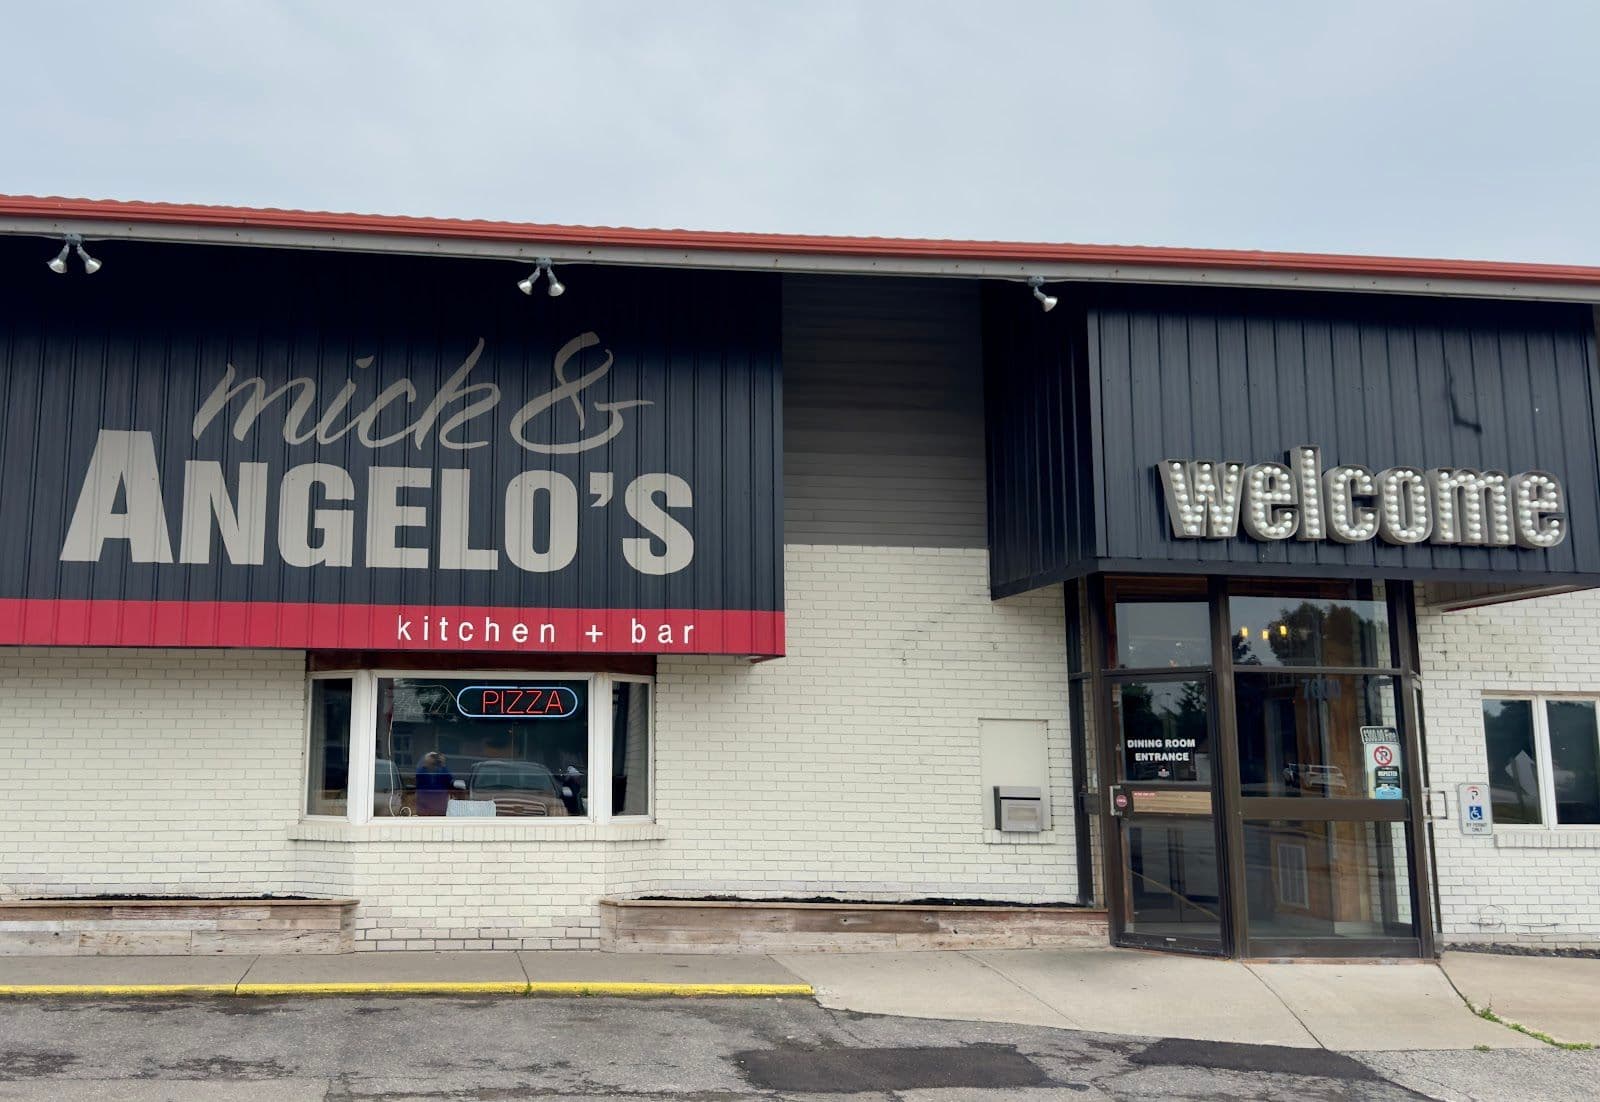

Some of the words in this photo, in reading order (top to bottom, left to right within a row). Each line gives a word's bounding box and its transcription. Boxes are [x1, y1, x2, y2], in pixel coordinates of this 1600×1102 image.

[192, 337, 500, 450] mick
[509, 332, 655, 454] &
[59, 429, 694, 575] ANGELO'S
[1157, 444, 1567, 549] welcome
[396, 615, 556, 643] kitchen
[631, 618, 695, 643] bar
[482, 690, 564, 714] PIZZA
[1127, 739, 1163, 749] DINING
[1165, 738, 1196, 748] ROOM
[1135, 752, 1190, 761] ENTRANCE
